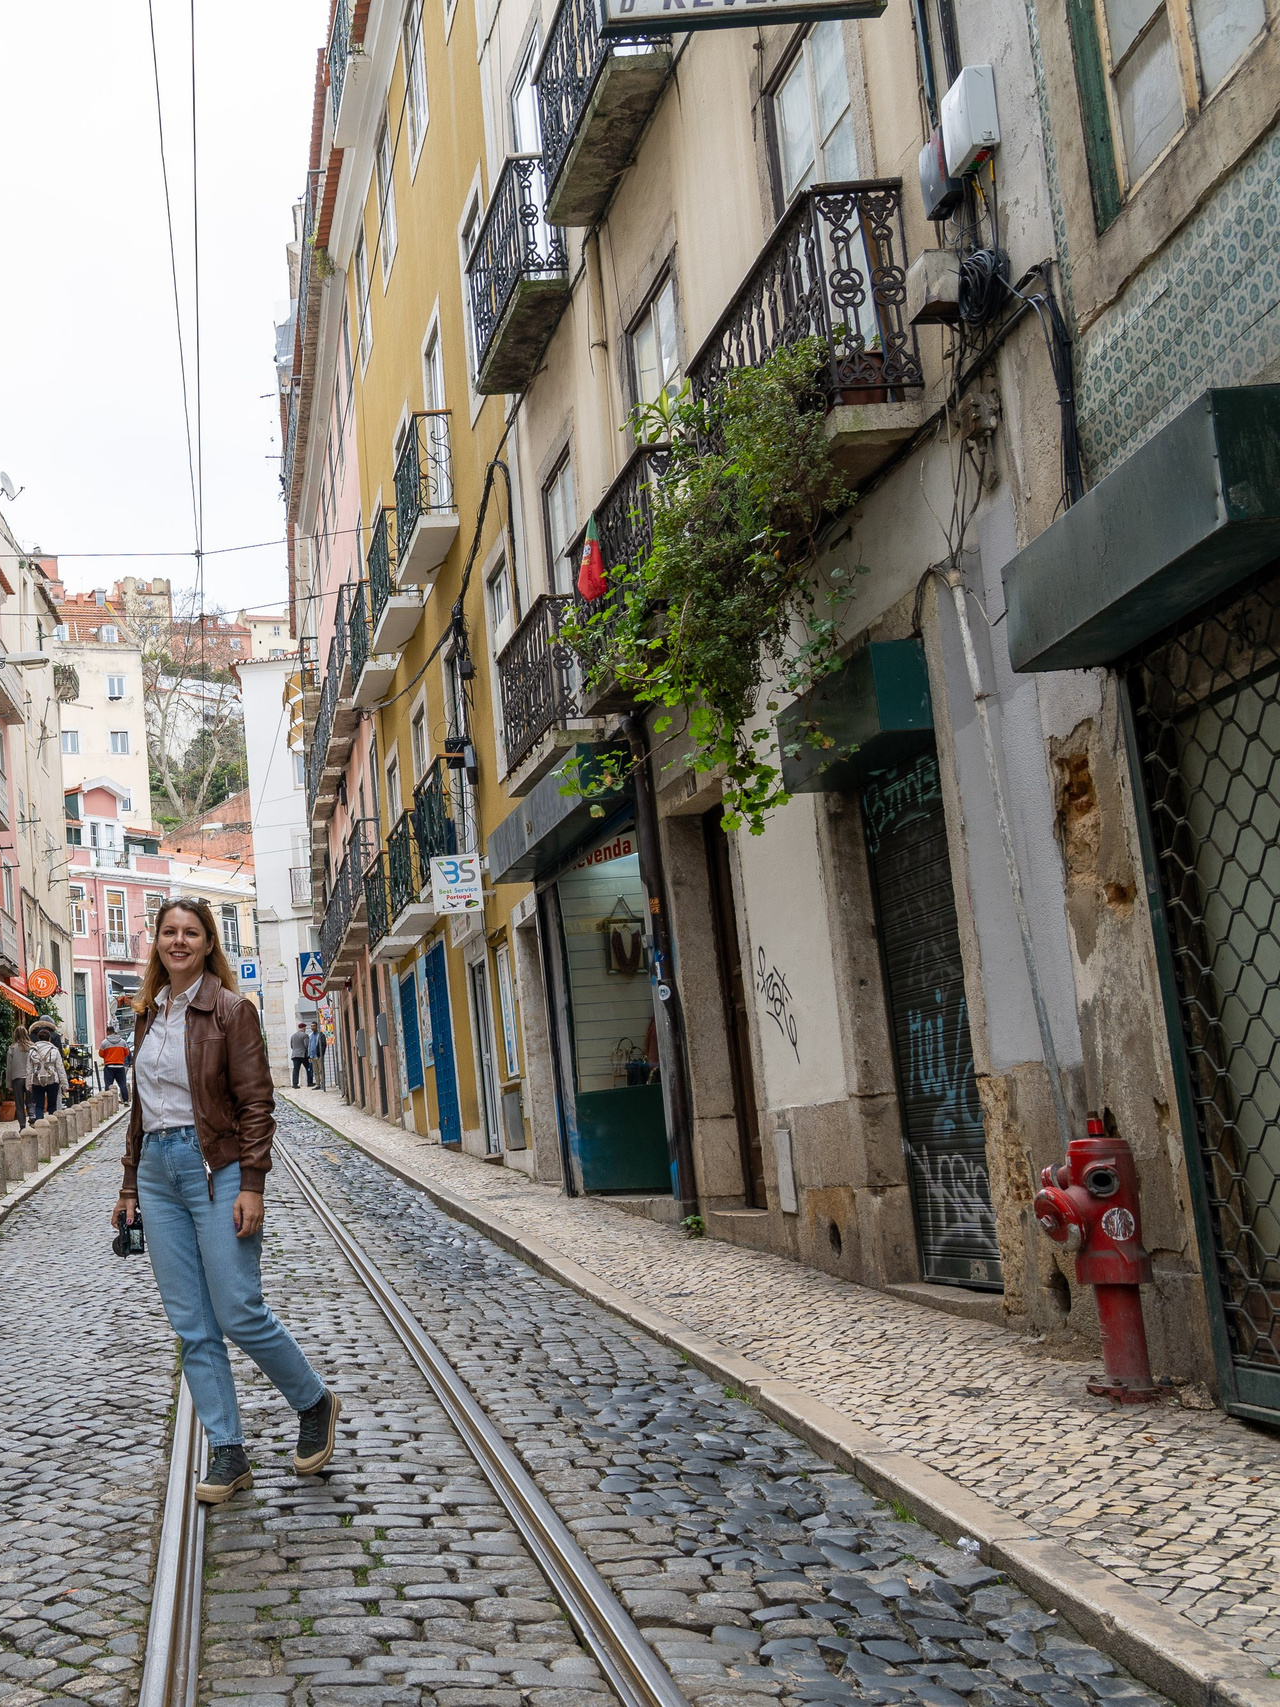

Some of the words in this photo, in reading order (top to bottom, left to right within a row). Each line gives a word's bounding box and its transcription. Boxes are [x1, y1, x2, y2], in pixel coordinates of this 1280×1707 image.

[573, 837, 632, 870] evenda
[454, 886, 478, 894] Service
[244, 966, 252, 977] P
